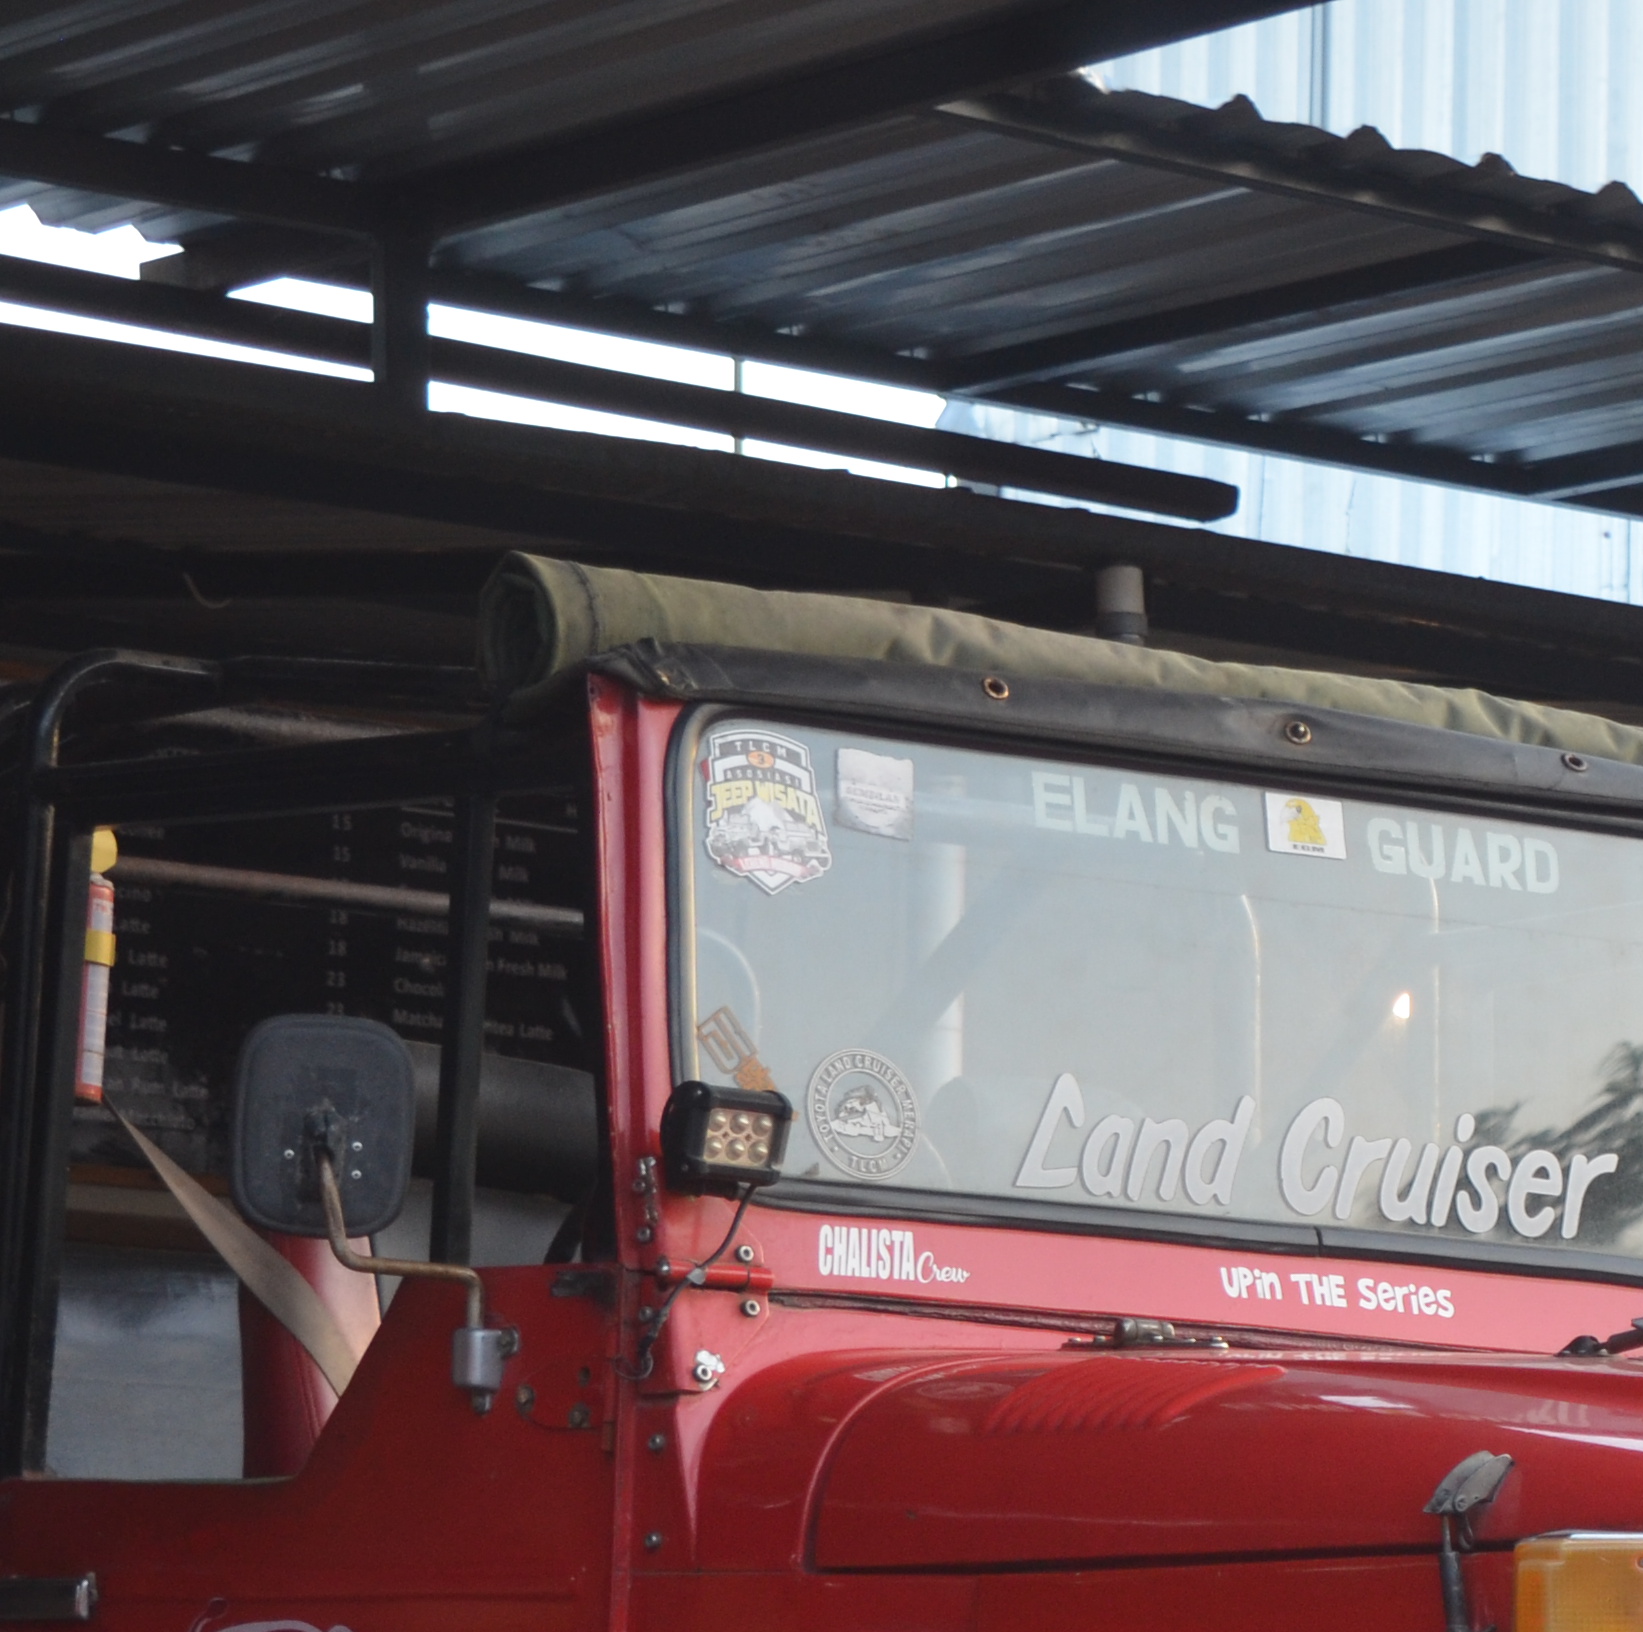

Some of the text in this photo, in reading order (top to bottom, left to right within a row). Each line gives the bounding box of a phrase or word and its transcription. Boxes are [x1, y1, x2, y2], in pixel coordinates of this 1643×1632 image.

[734, 740, 788, 758] TLCM
[725, 768, 800, 788] ASOSIASI
[710, 780, 822, 833] JEEP WISATA
[400, 820, 453, 845] Origina
[1031, 769, 1560, 895] ELANG GUARD
[822, 1055, 853, 1084] LAND
[856, 1054, 908, 1097] CRUISER
[814, 1082, 831, 1141] TOYOTA
[1015, 1072, 1256, 1206] Land
[1279, 1097, 1618, 1239] Cruiser
[818, 1224, 971, 1285] CHALISTA Crew
[1290, 1272, 1347, 1308] THE
